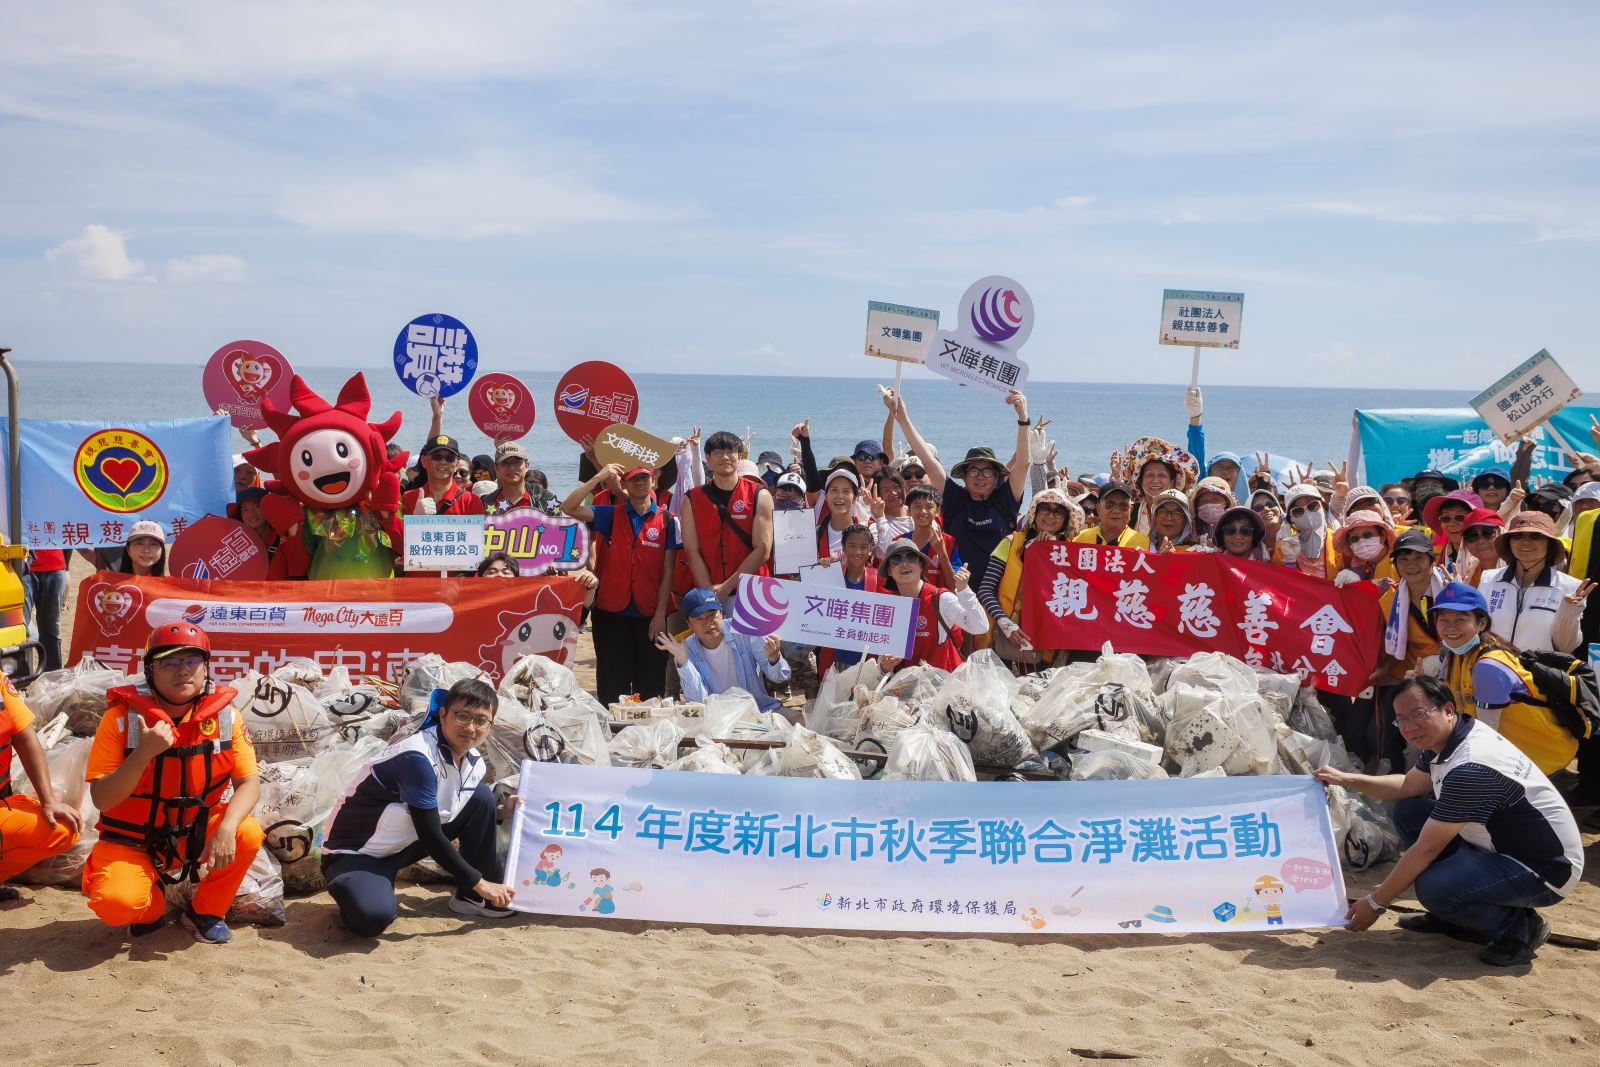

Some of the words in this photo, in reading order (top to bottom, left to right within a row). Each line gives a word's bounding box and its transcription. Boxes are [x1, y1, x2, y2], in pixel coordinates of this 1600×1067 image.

[1178, 306, 1224, 319] 社團法人
[881, 325, 922, 342] 文曄集團
[1172, 320, 1229, 333] 親慈慈善會
[939, 339, 1020, 387] 文曄集團
[1496, 374, 1545, 412] 國泰世華
[1506, 385, 1554, 422] 松山分行
[603, 432, 660, 466] 文曄科技
[421, 531, 467, 542] 遠東百貨
[484, 524, 539, 559] 中山
[410, 545, 478, 556] 股份有限公司
[1049, 545, 1156, 574] 社團法人
[210, 606, 287, 621] 遠東百貨
[302, 606, 334, 627] Mega
[336, 606, 360, 628] City
[804, 595, 895, 628] 文曄集團
[1046, 572, 1353, 655] 親慈慈善會
[835, 626, 890, 645] 全員動起來
[543, 802, 623, 839] 114
[635, 804, 1281, 865] 年度新北市秋季聯合淨灘活動
[836, 896, 1016, 916] 新北市政府環境保護局
